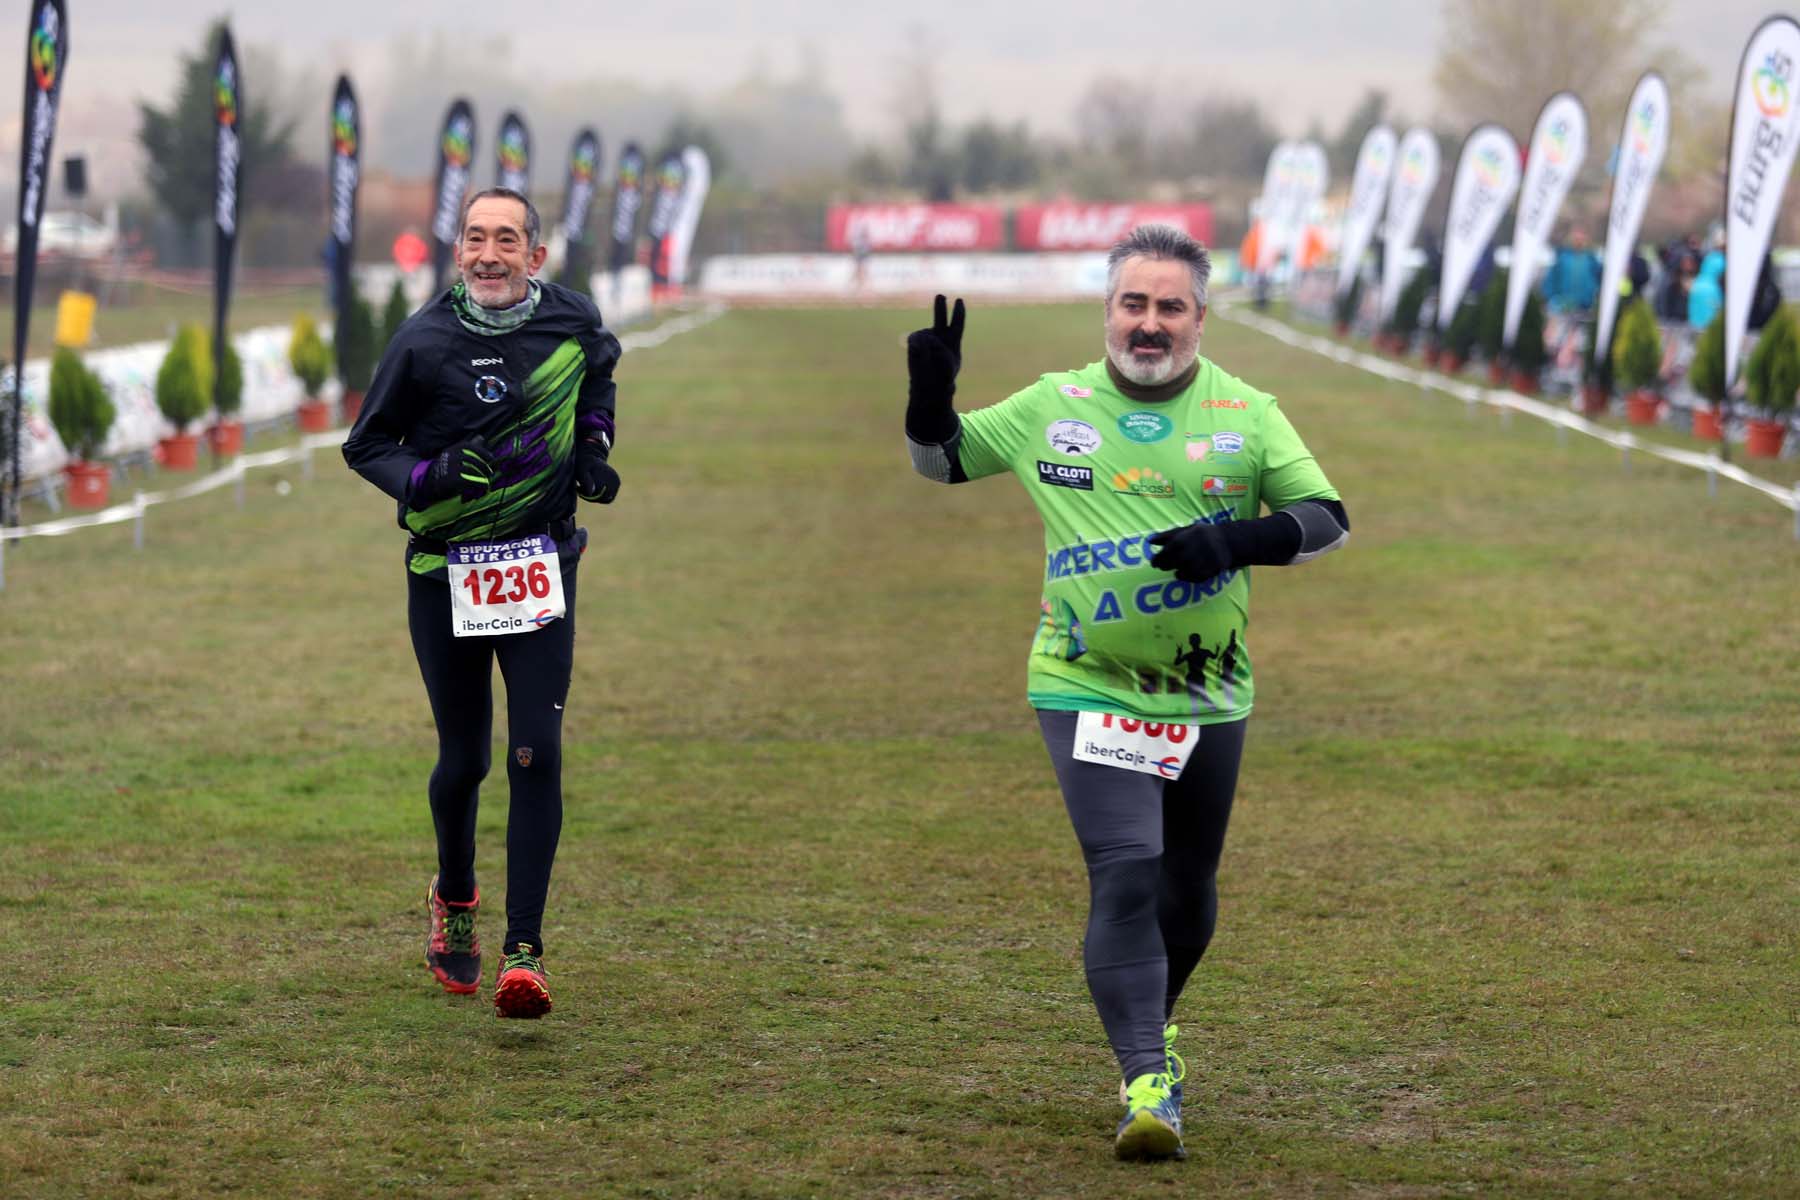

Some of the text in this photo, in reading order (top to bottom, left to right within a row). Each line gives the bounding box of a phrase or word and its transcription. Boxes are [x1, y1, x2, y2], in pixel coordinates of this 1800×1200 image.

[1039, 463, 1055, 475] LA
[1056, 466, 1091, 480] CLOTI
[459, 546, 544, 563] BURGOS
[463, 561, 551, 606] 1236
[1093, 590, 1122, 622] A
[462, 616, 524, 631] iberCaja
[1084, 741, 1147, 766] iberCaja
